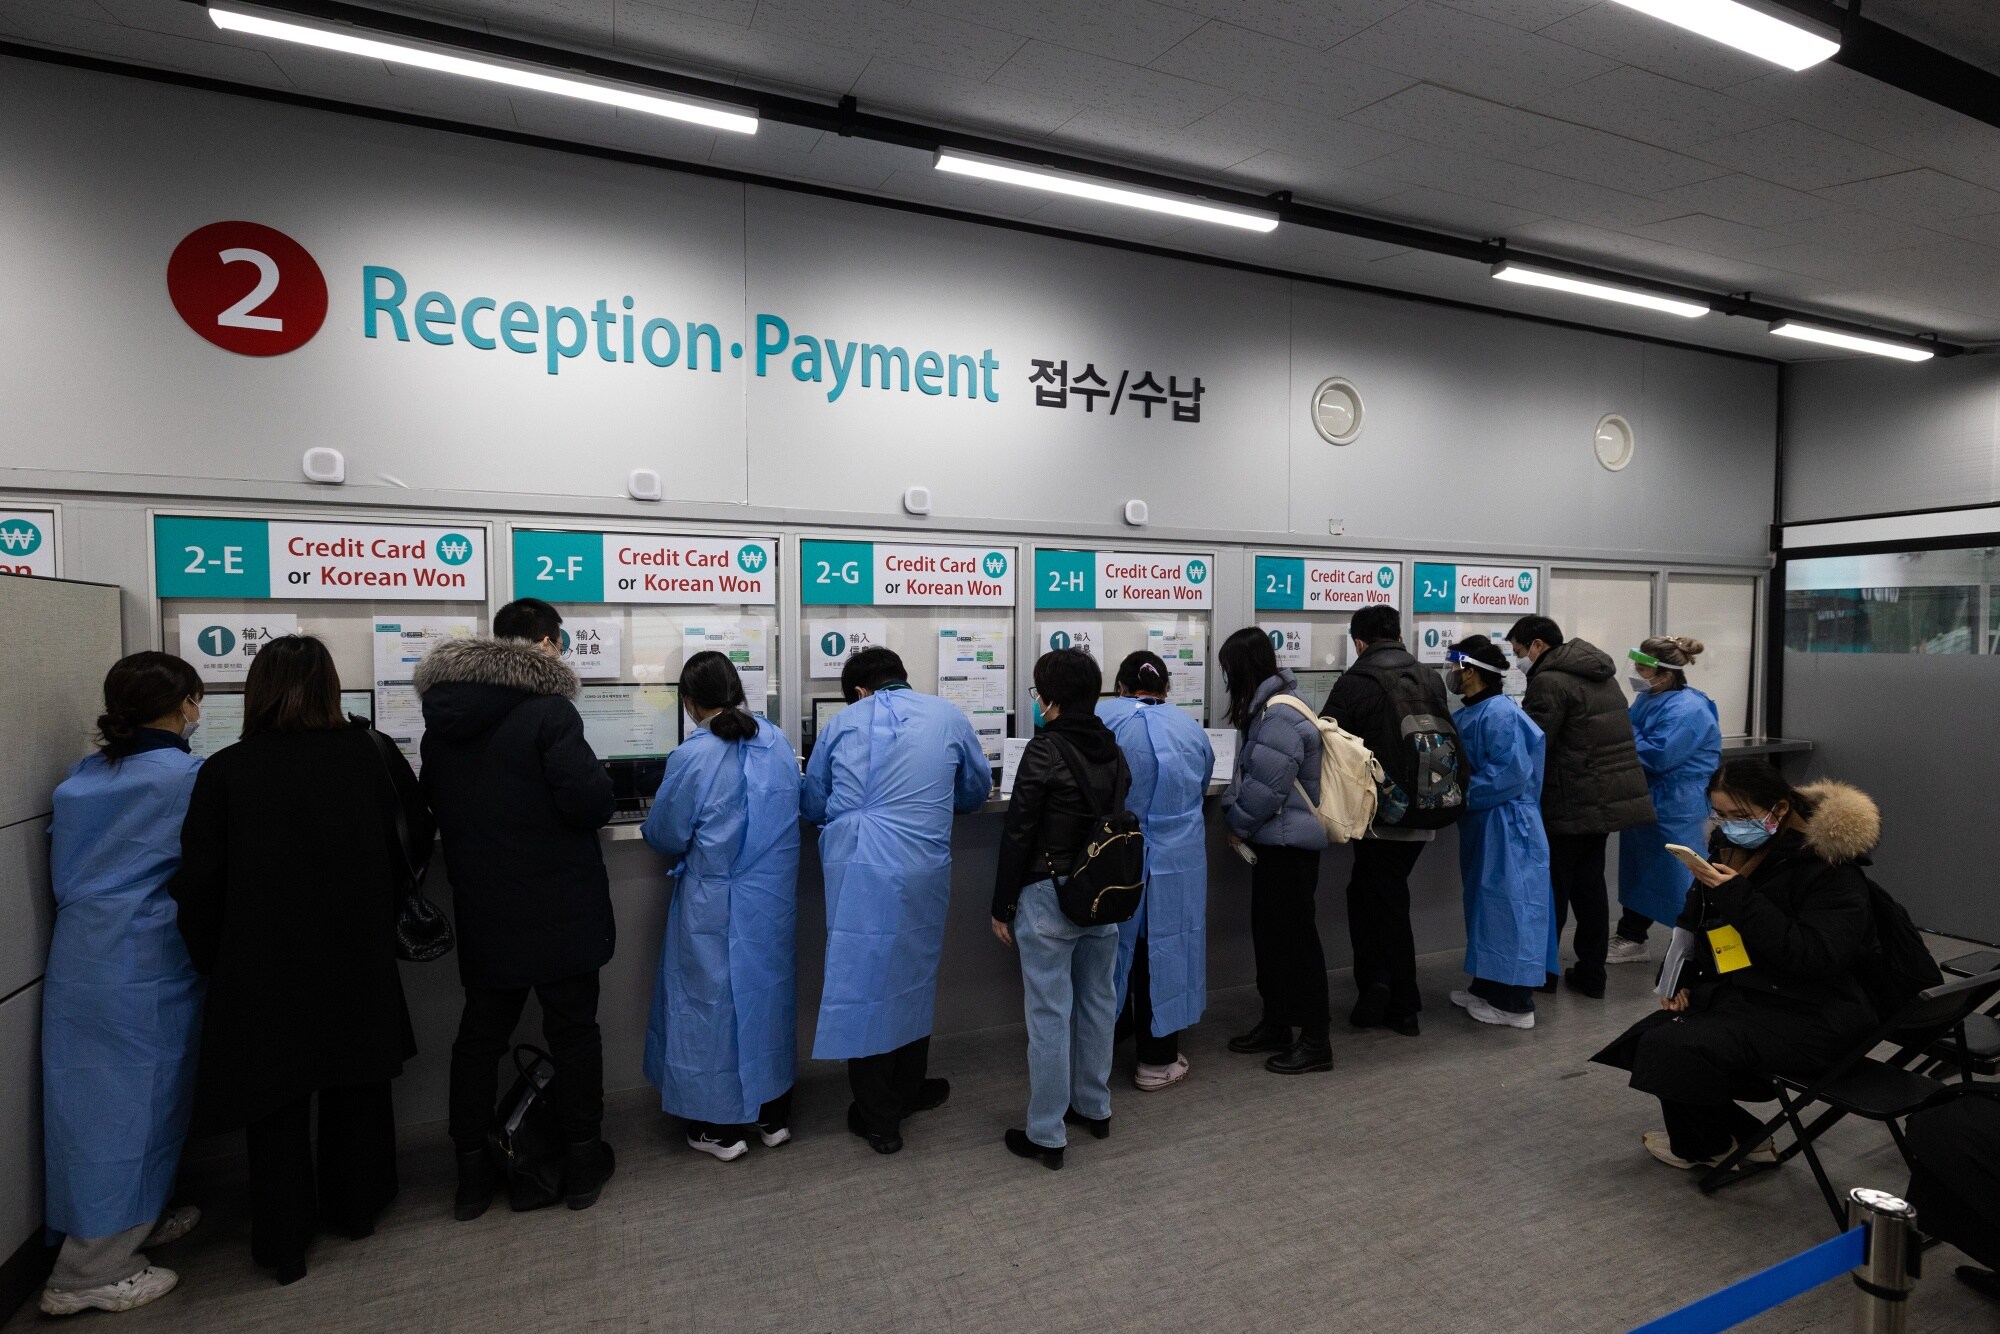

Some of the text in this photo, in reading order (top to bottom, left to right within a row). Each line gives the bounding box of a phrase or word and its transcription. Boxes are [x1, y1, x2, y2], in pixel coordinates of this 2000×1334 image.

[217, 248, 283, 331] 2
[1029, 358, 1204, 422] 접수/수납
[288, 537, 364, 558] Credit
[371, 539, 426, 560] Card
[185, 546, 243, 573] 2-E
[618, 547, 680, 568] Credit
[685, 548, 730, 568] Card
[885, 556, 935, 573] Credit
[939, 556, 976, 574] Card
[537, 556, 582, 580] 2-F
[817, 562, 858, 583] 2-G
[1105, 564, 1147, 579] Credit
[1150, 565, 1181, 580] Card
[288, 565, 465, 588] or Korean Won
[618, 574, 761, 592] or Korean Won
[1049, 572, 1083, 591] 2-H
[1267, 575, 1291, 594] 2-I
[1312, 569, 1344, 583] Credit
[1347, 571, 1373, 584] Card
[1462, 576, 1490, 587] Credit
[1493, 576, 1514, 588] Card
[885, 579, 1002, 596] or Korean Won
[1105, 586, 1202, 600] or Korean Won
[1424, 581, 1447, 597] 2-J
[1310, 589, 1391, 603] or Korean Won
[1461, 594, 1529, 605] or Korean Won
[242, 627, 273, 640] 输入
[576, 629, 601, 641] 输入
[850, 633, 870, 643] 输入
[1055, 633, 1064, 649] 1
[1073, 632, 1091, 641] 输入
[1271, 632, 1279, 650] 1
[1286, 631, 1301, 640] 输入
[1428, 630, 1436, 646] 1
[207, 629, 223, 655] 1
[576, 643, 601, 655] 信息
[828, 635, 836, 655] 1
[1286, 642, 1301, 651] 信息
